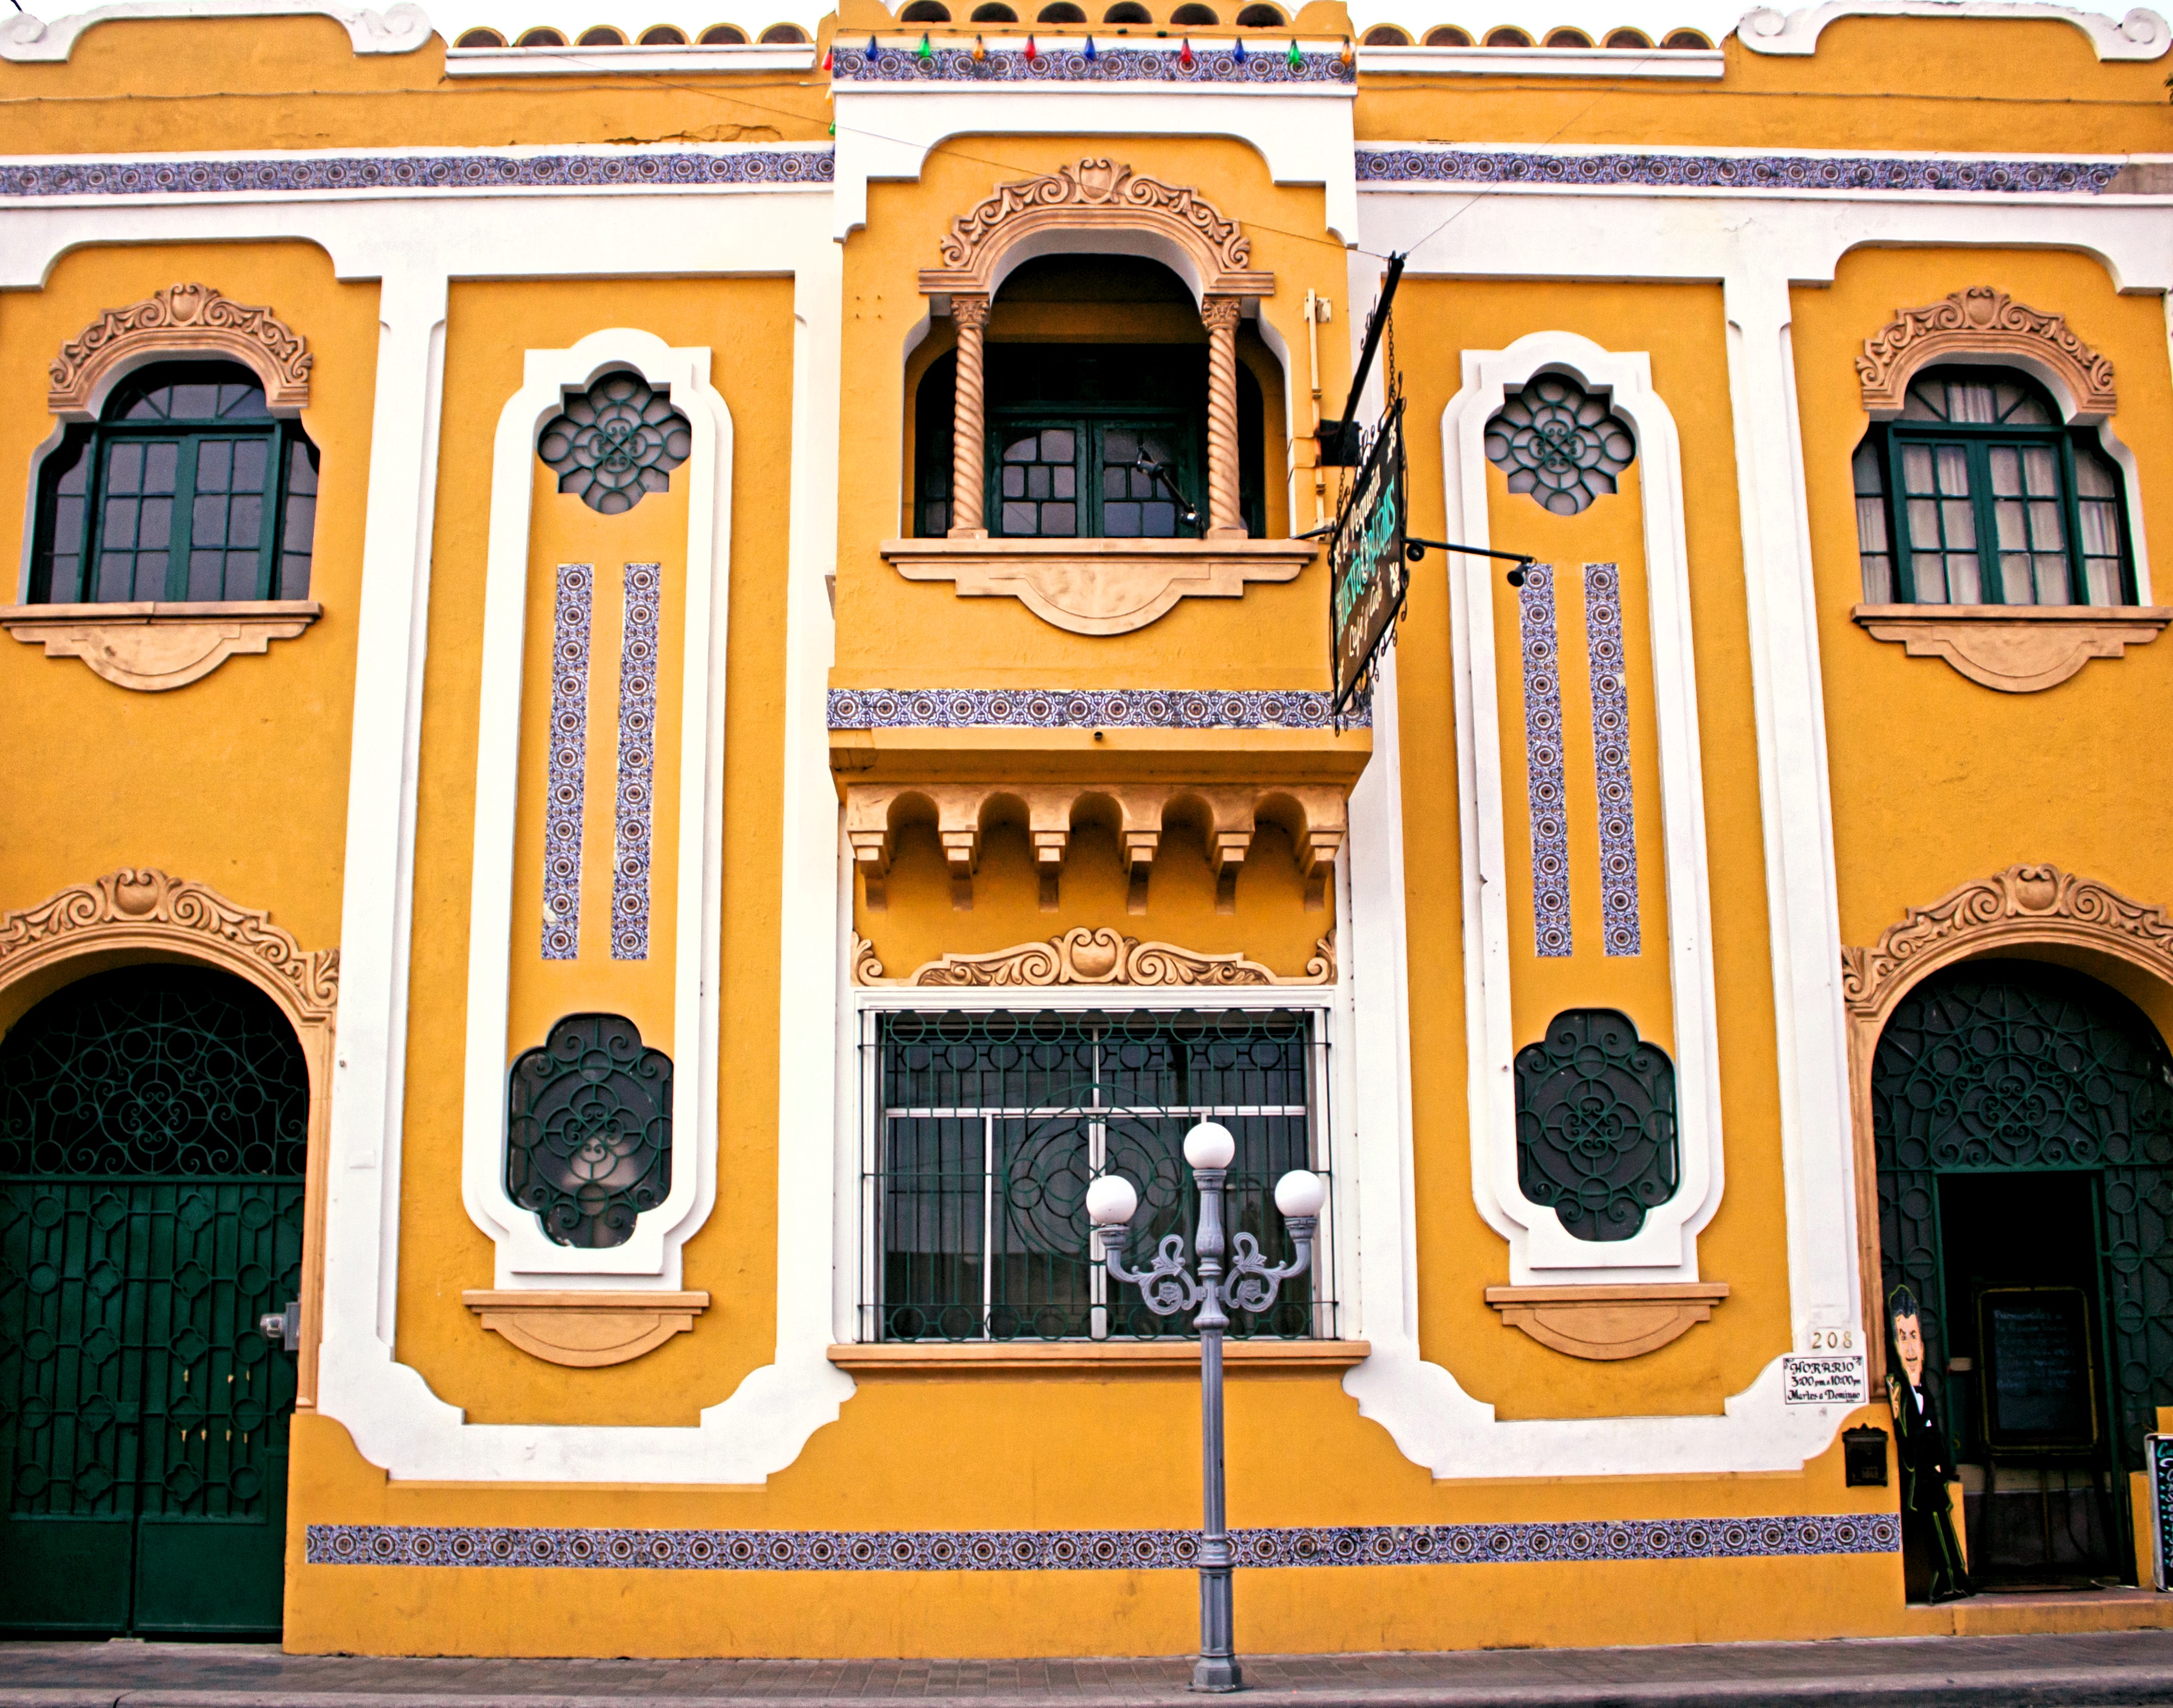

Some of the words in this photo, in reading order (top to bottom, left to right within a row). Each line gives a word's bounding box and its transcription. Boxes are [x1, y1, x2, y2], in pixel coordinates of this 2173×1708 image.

[1811, 1331, 1853, 1349] 208
[1790, 1361, 1854, 1375] HORARIO
[1787, 1390, 1818, 1400] Martes
